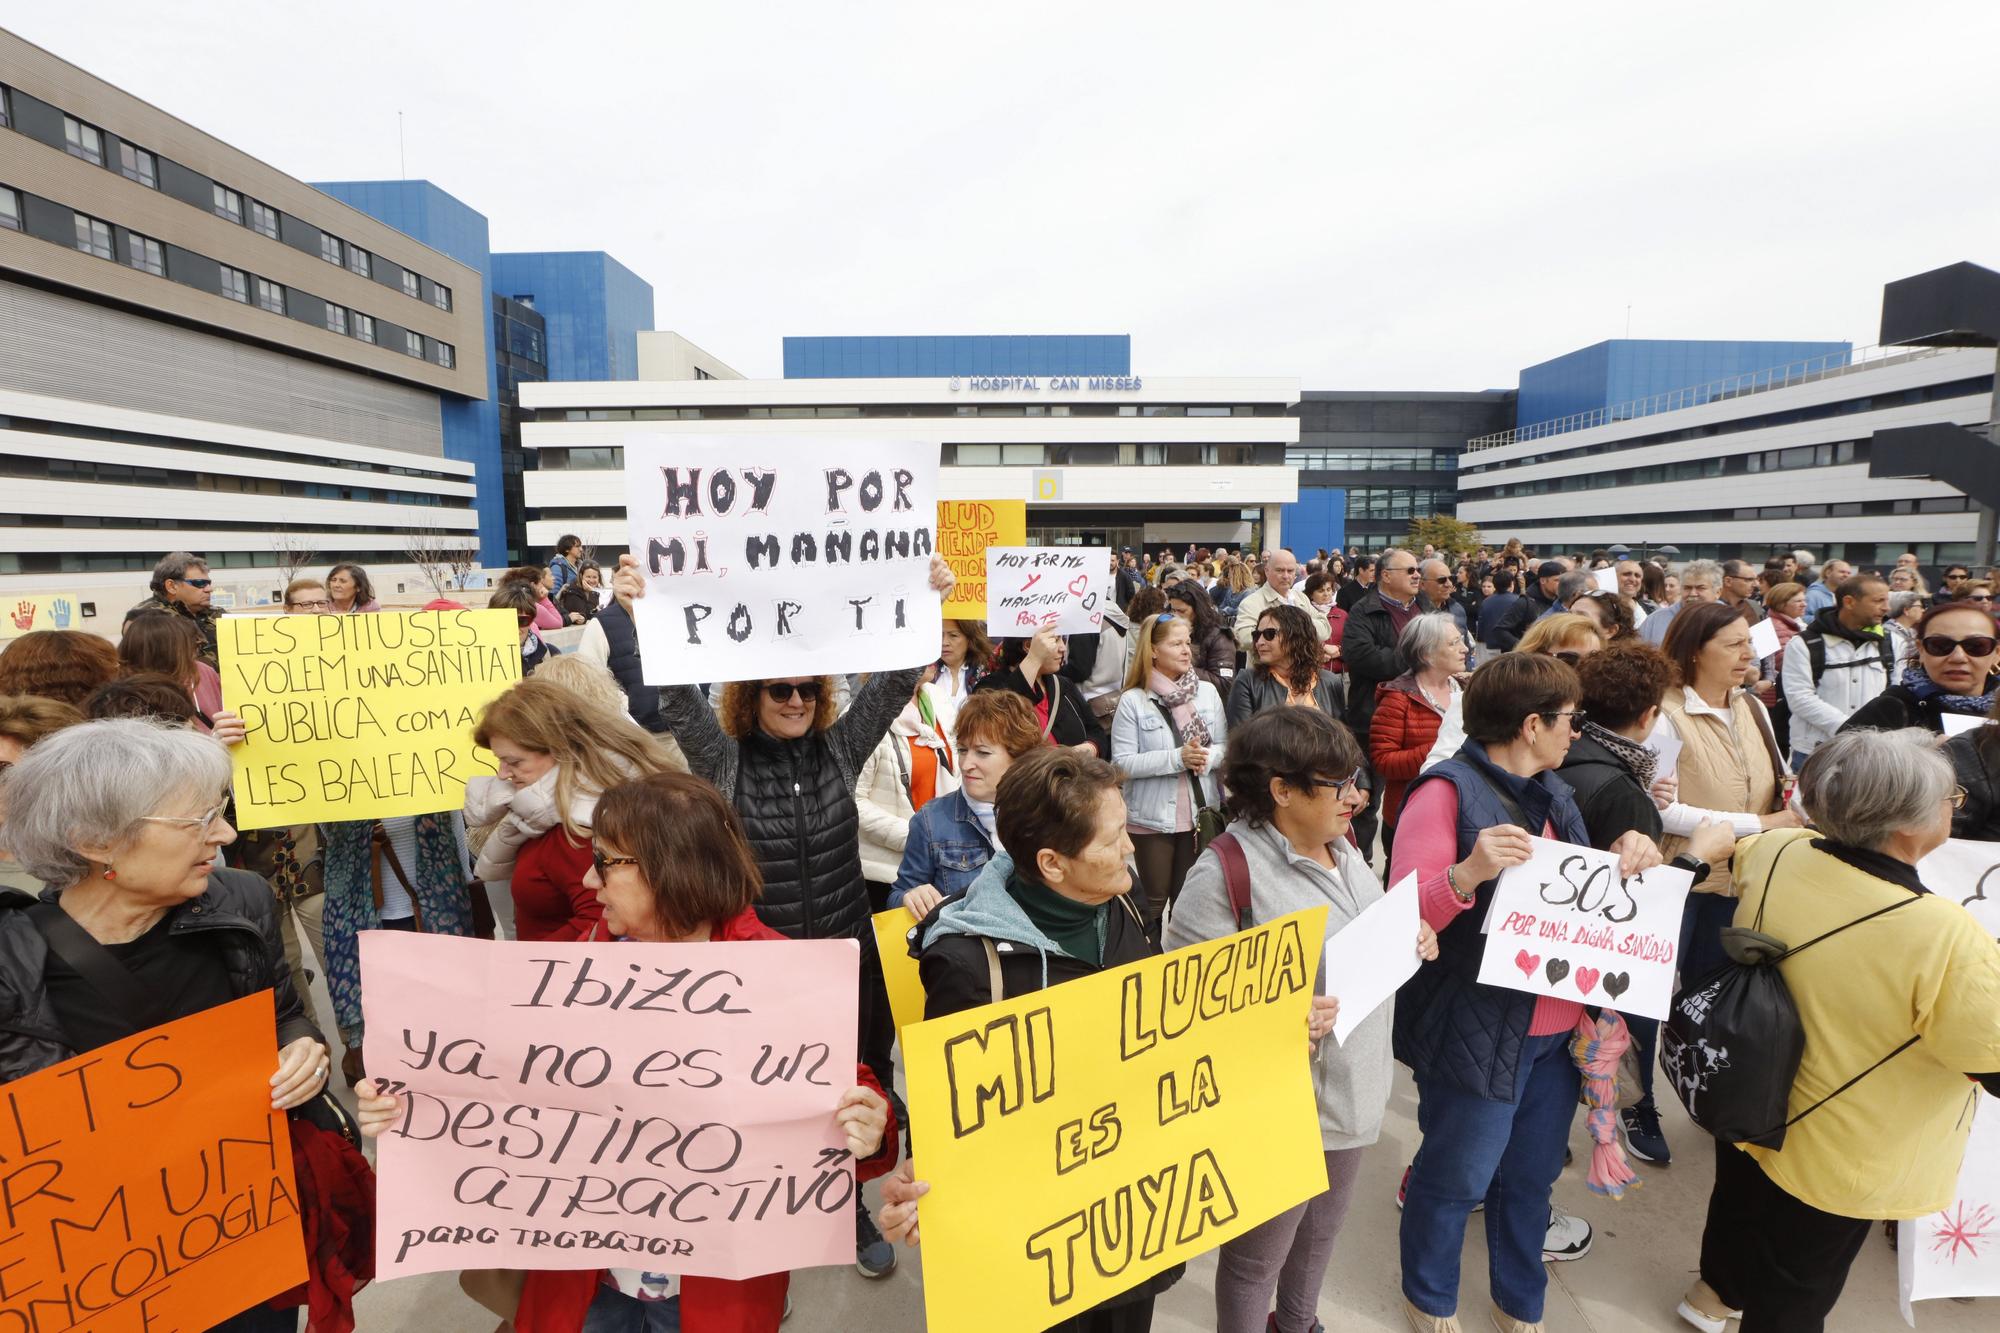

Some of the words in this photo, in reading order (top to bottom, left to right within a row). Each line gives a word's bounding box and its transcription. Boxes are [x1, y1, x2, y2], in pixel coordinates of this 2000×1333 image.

[970, 376, 1040, 391] HOSPITAL
[1050, 376, 1080, 391] CAN
[1089, 376, 1142, 391] MISSES
[661, 466, 777, 520] HOY
[823, 468, 914, 516] POR
[1039, 479, 1057, 499] D
[745, 520, 932, 571] MAÑANA
[996, 553, 1029, 568] HOY
[1031, 553, 1060, 568] POR
[1020, 574, 1041, 592] Y
[234, 617, 296, 656] LES
[317, 609, 478, 652] PITIUSES
[682, 600, 803, 649] POR
[1016, 610, 1037, 626] POR
[236, 654, 348, 695] VOLEM
[405, 644, 518, 687] SANITAT
[240, 695, 387, 746] PÚBLICA
[245, 763, 306, 806] LES
[318, 745, 499, 803] BALEARS
[1500, 911, 1536, 936] POR
[1539, 919, 1568, 943] UNA
[1618, 933, 1673, 964] SANIDAD
[511, 957, 752, 1015] Ibiza
[944, 1006, 1055, 1139] MI
[1120, 920, 1307, 1061] LUCHA
[400, 1028, 500, 1080] ya
[519, 1044, 612, 1089] no
[632, 1048, 723, 1088] es
[750, 1043, 831, 1086] un
[1056, 1102, 1122, 1176] ES
[1158, 1054, 1221, 1126] LA
[1026, 1148, 1239, 1306] TUYA
